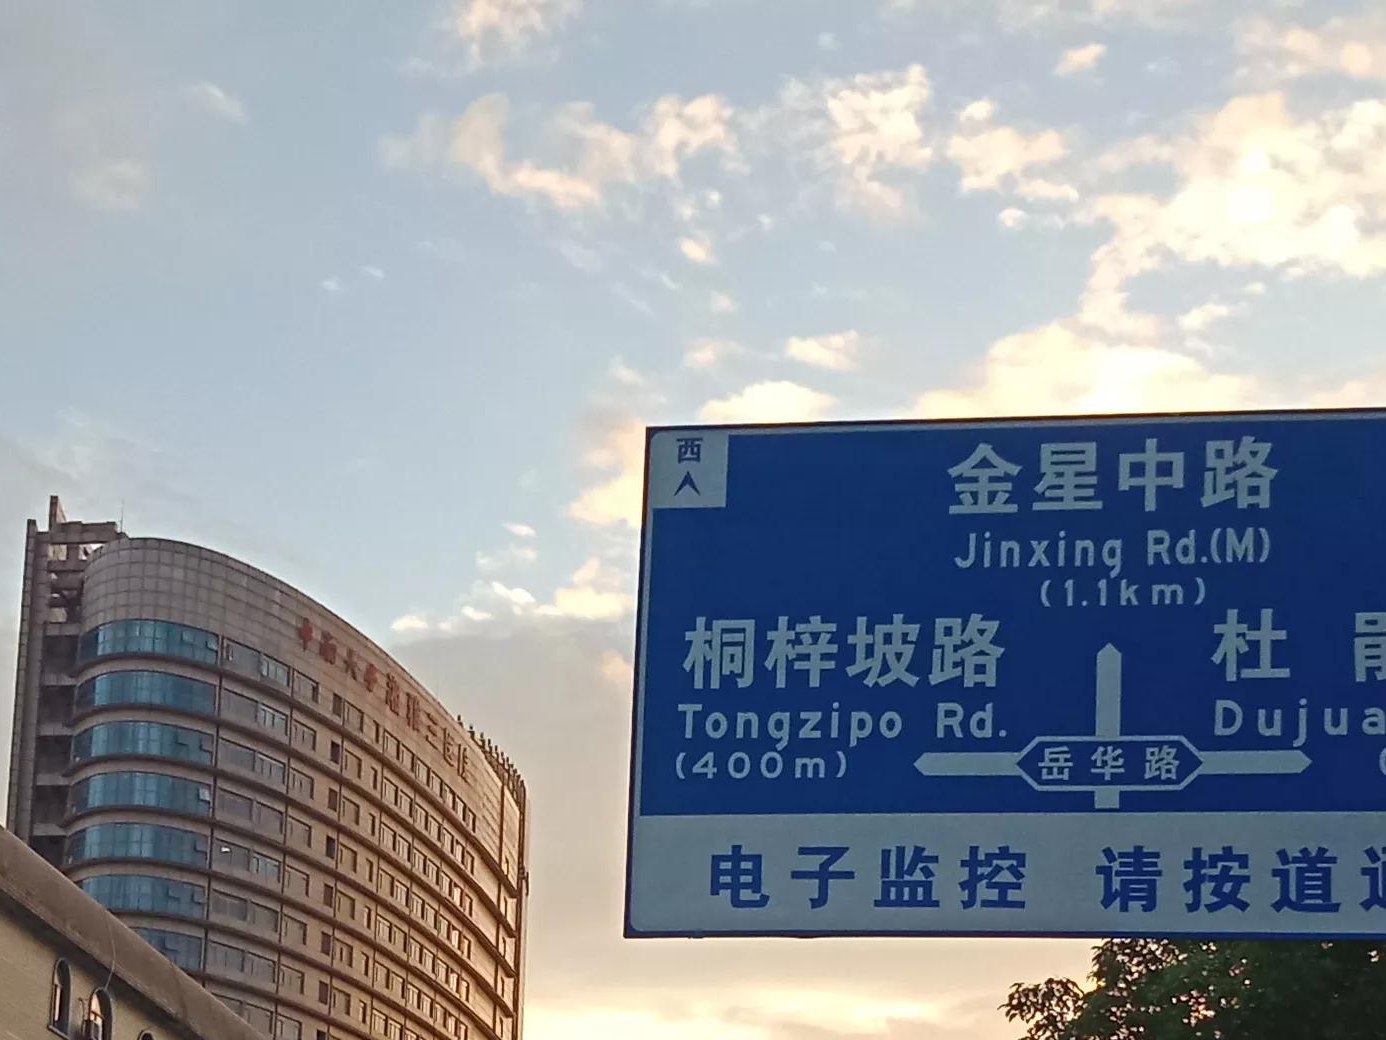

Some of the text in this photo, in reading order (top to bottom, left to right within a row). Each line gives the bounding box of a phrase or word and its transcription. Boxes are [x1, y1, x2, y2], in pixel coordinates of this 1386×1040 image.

[676, 437, 703, 464] 西
[948, 436, 1278, 514] 金星中路
[955, 531, 1122, 578] Jinxing
[1040, 577, 1206, 607] (1.1km)
[683, 613, 1005, 689] 桐梓坡路
[678, 702, 1007, 750] Tongzipo Rd.
[675, 750, 847, 779] (400m)
[1036, 746, 1182, 782] 岳华路
[710, 844, 1027, 910] 电子监控
